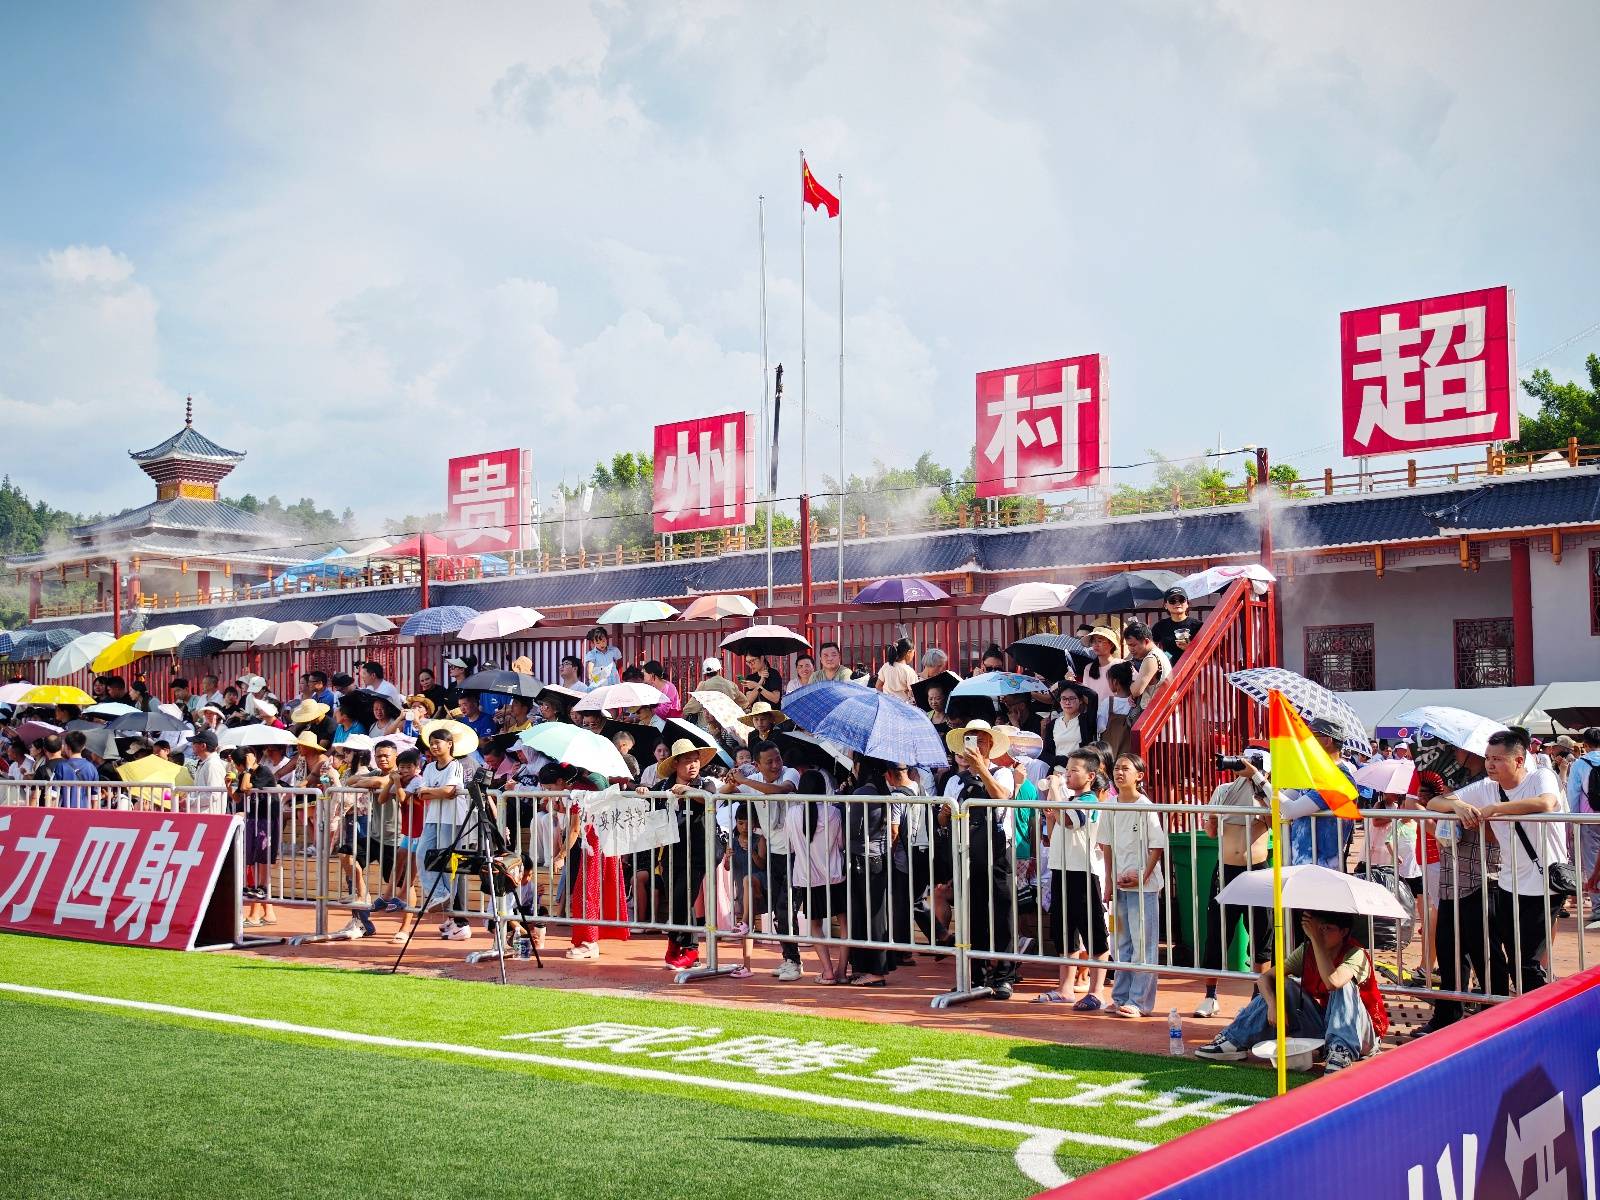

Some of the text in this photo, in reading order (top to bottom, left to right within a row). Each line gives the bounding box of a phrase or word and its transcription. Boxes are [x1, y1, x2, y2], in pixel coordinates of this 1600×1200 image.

[452, 305, 1498, 549] 贵 州 村 超
[0, 814, 208, 943] 力四射
